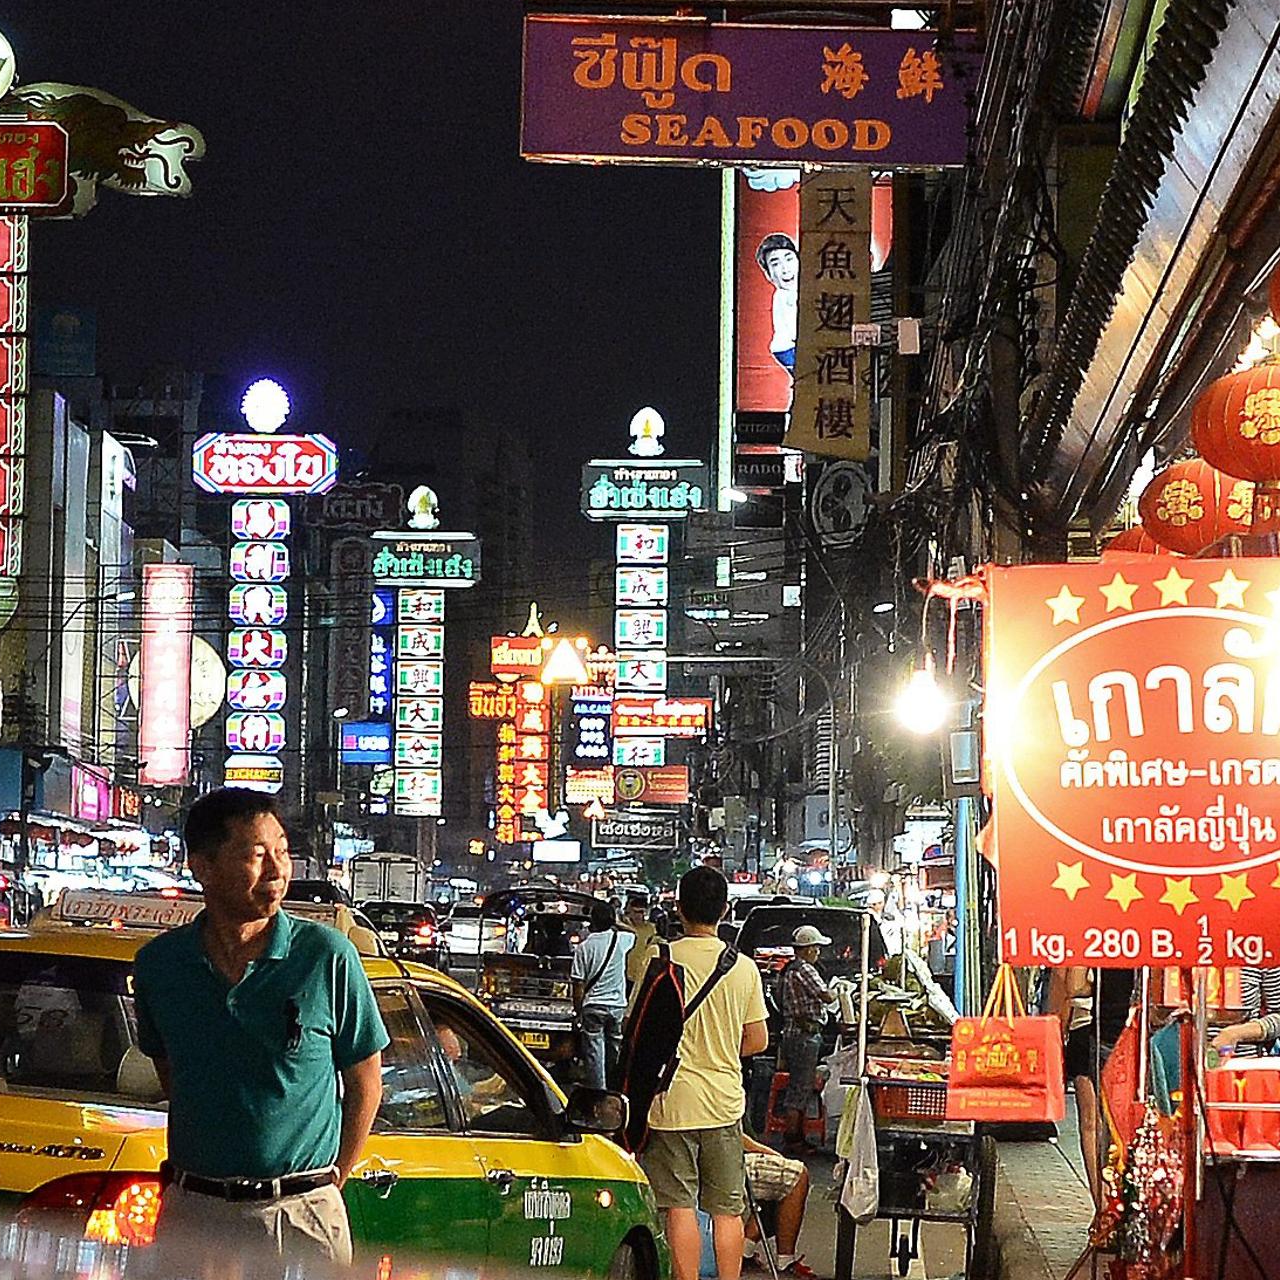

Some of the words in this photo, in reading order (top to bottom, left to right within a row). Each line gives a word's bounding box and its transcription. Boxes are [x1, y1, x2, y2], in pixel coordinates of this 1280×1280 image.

[820, 43, 944, 105] 海鮮
[620, 114, 893, 151] SEAFOOD
[737, 463, 781, 475] RADO
[1004, 929, 1017, 957] 1
[1030, 928, 1074, 964] kg.
[1083, 928, 1141, 958] 280
[1150, 929, 1183, 958] B.
[1226, 929, 1273, 965] kg.
